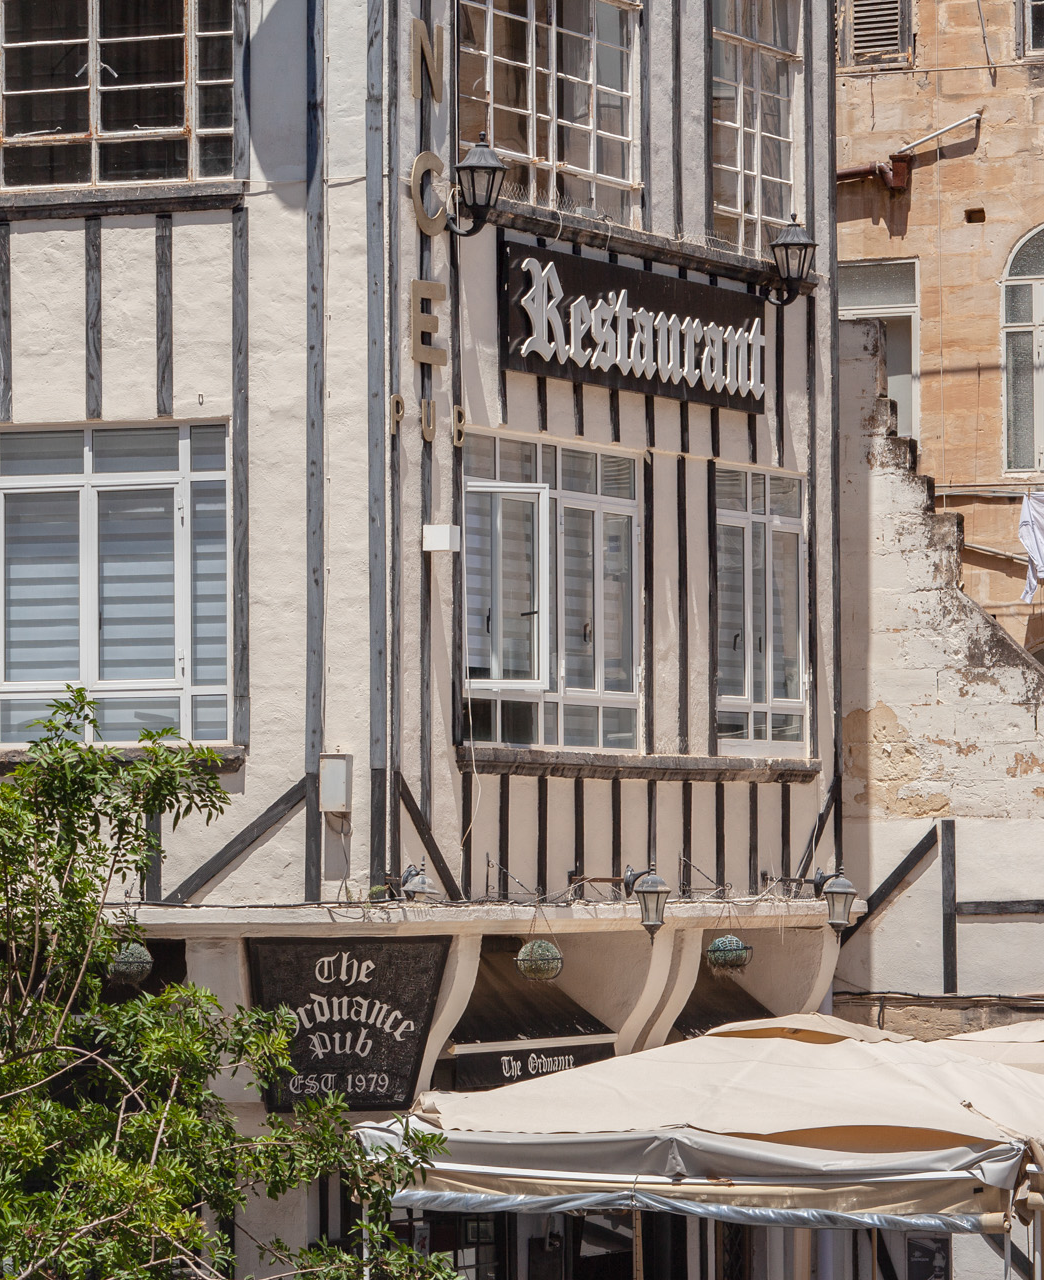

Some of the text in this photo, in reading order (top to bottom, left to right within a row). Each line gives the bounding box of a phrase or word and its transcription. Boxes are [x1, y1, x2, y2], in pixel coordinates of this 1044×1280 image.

[520, 257, 766, 401] Restaurant
[390, 393, 466, 448] PUB
[315, 951, 376, 986] The
[289, 1073, 390, 1094] EST 1979
[500, 1052, 576, 1081] The Ordnance
